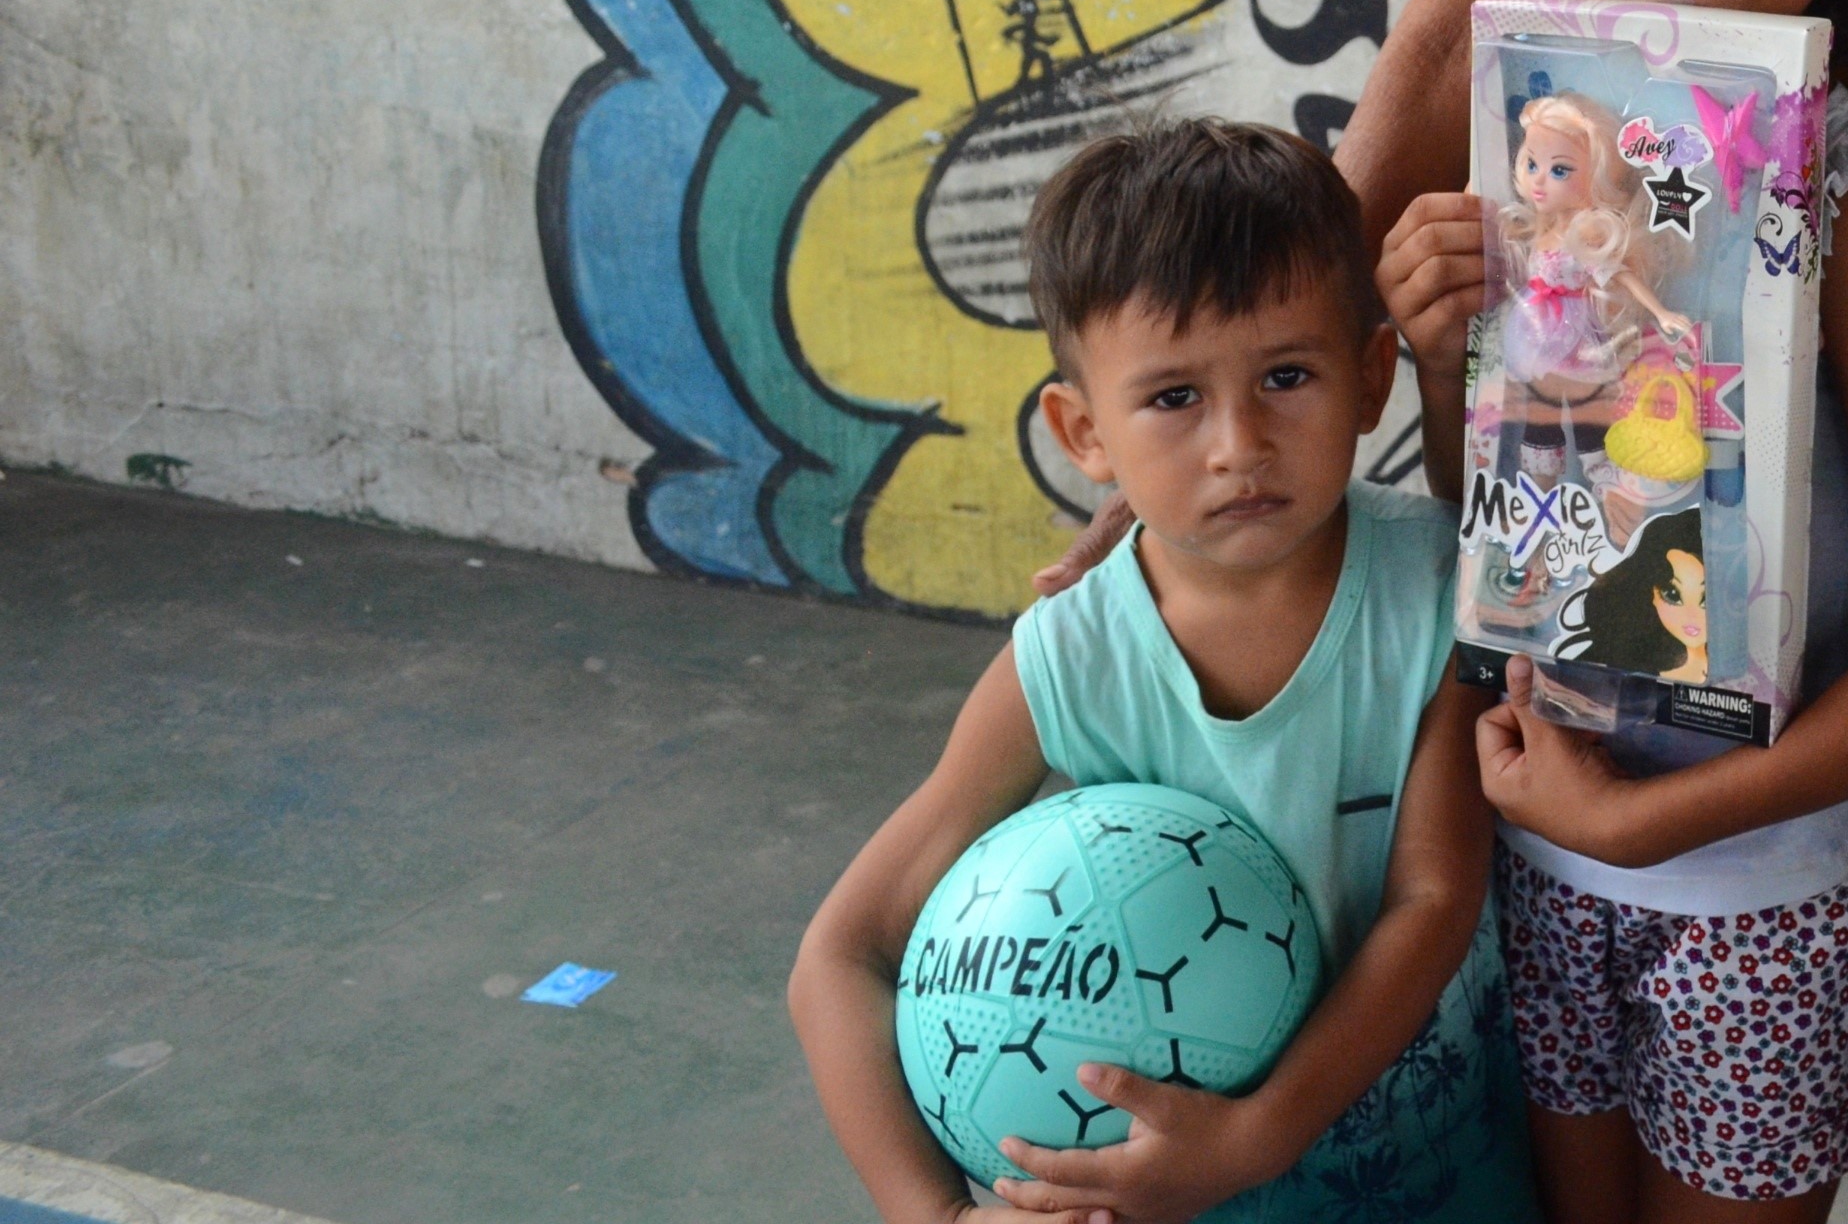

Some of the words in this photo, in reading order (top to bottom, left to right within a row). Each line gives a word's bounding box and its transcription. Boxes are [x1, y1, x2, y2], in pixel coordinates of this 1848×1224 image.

[1625, 136, 1677, 162] Avey
[1546, 530, 1607, 574] girlz
[1688, 688, 1752, 715] WARNING:
[915, 924, 1120, 1004] CAMPEÃO
